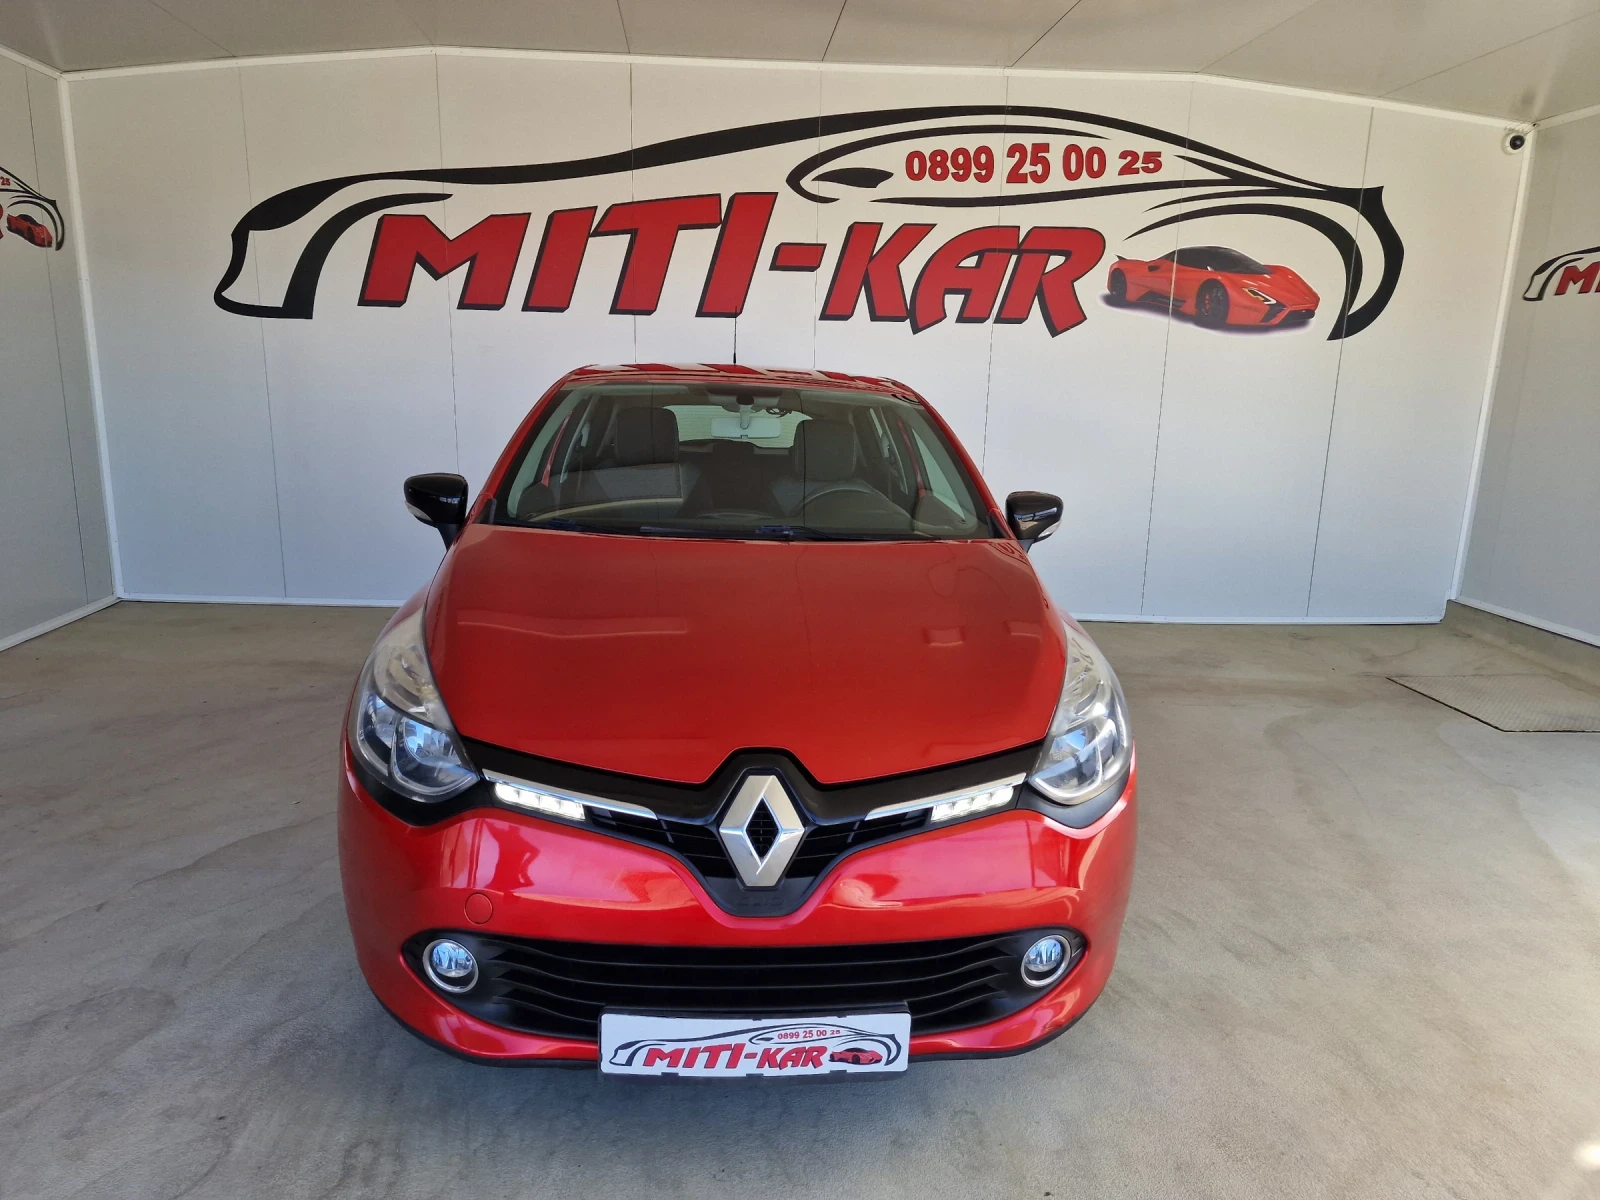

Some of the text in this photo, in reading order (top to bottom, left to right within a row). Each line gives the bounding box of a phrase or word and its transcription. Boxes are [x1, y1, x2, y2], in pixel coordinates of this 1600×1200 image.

[905, 142, 1163, 184] 0899 25 00 25
[357, 191, 1106, 337] MITI-KAR
[1553, 260, 1600, 296] M
[777, 1031, 800, 1040] 0899
[802, 1030, 814, 1039] 25
[816, 1029, 827, 1038] 00
[643, 1042, 828, 1071] MITI-KAR
